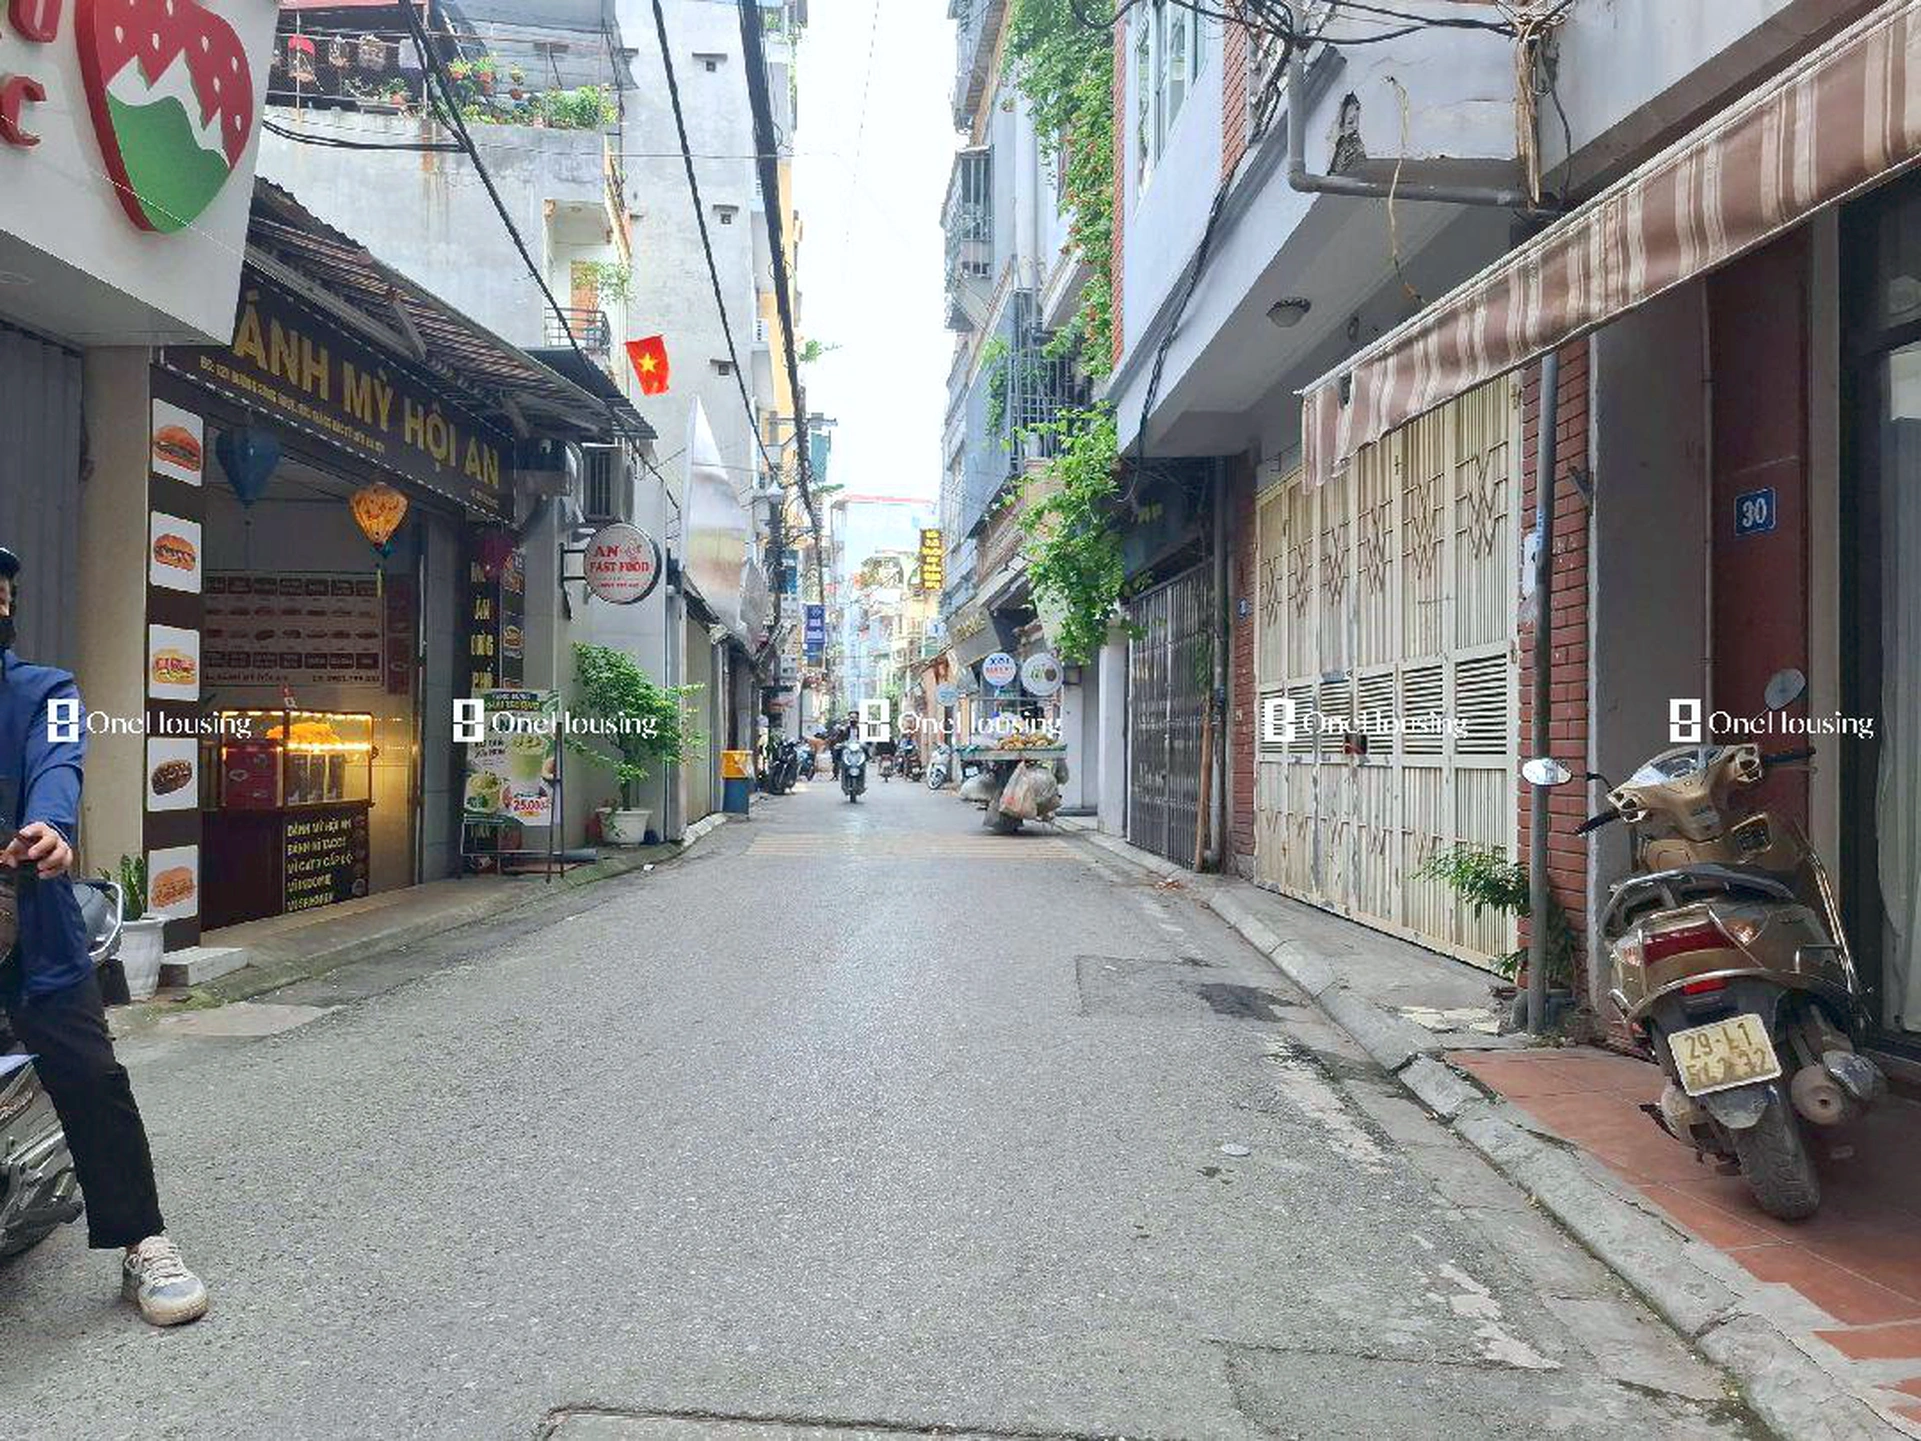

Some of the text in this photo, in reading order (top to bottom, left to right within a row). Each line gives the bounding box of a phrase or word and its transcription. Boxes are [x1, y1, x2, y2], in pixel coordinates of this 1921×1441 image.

[404, 398, 457, 472] HỘI
[464, 436, 499, 489] AN
[1742, 498, 1767, 527] 30
[594, 545, 620, 557] AN
[590, 561, 649, 573] FAST FOOD
